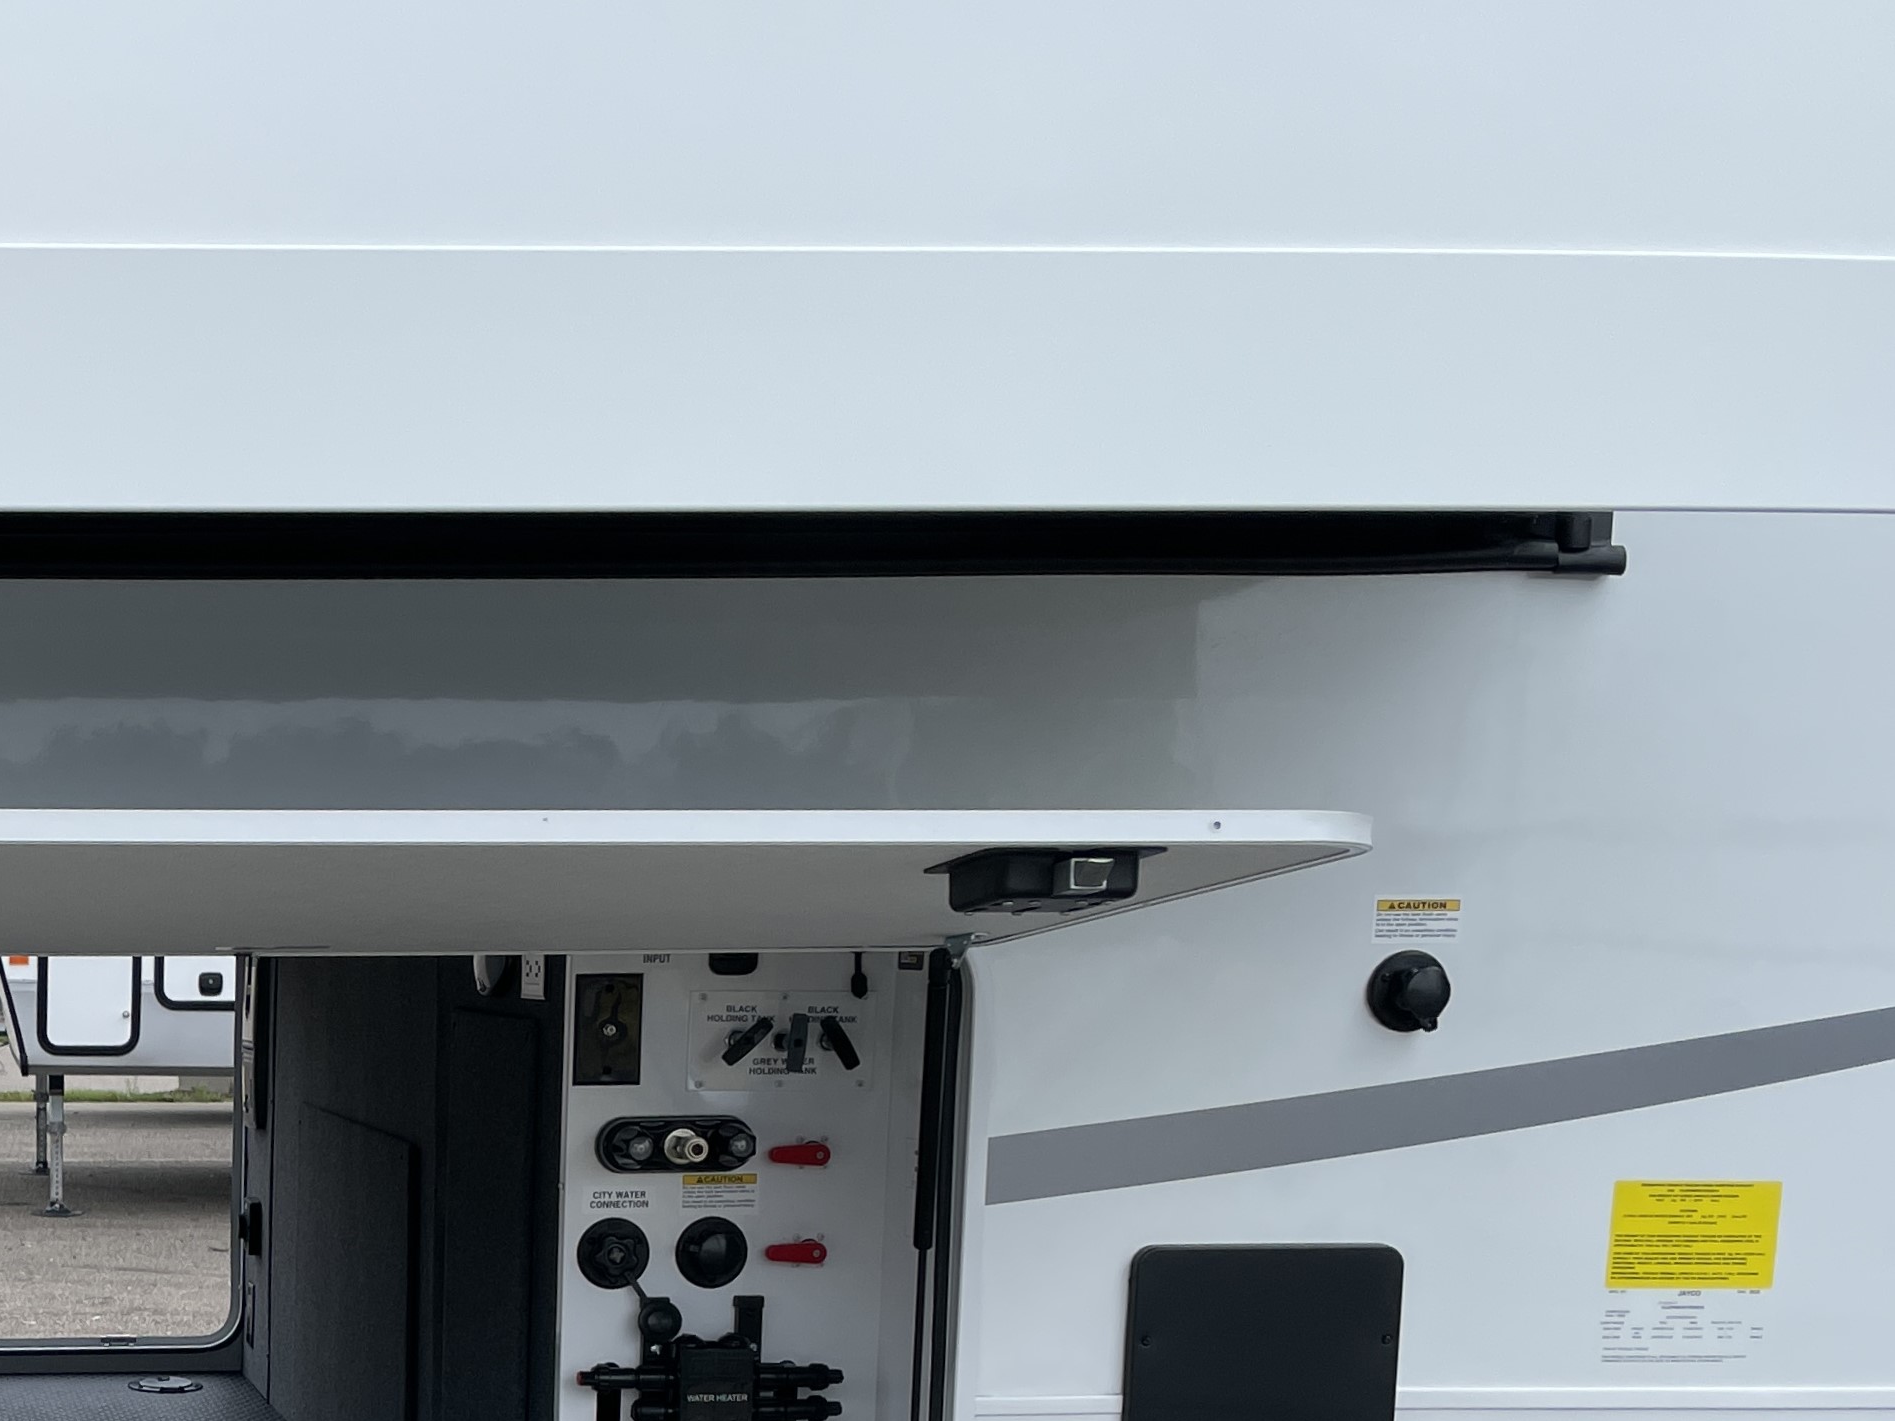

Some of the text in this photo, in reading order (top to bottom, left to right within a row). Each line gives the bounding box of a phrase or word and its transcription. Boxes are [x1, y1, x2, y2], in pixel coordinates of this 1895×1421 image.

[1397, 901, 1447, 910] CAUTION
[643, 953, 671, 964] INPUT
[726, 1004, 758, 1013] BLACK
[808, 1005, 839, 1014] BLACK
[707, 1014, 748, 1023] HOLDING
[752, 1057, 779, 1066] GREY
[704, 1175, 743, 1184] CAUTION
[592, 1190, 646, 1199] CITY WATER
[589, 1200, 649, 1209] CONNECTION
[687, 1393, 748, 1402] WATER HEATER
